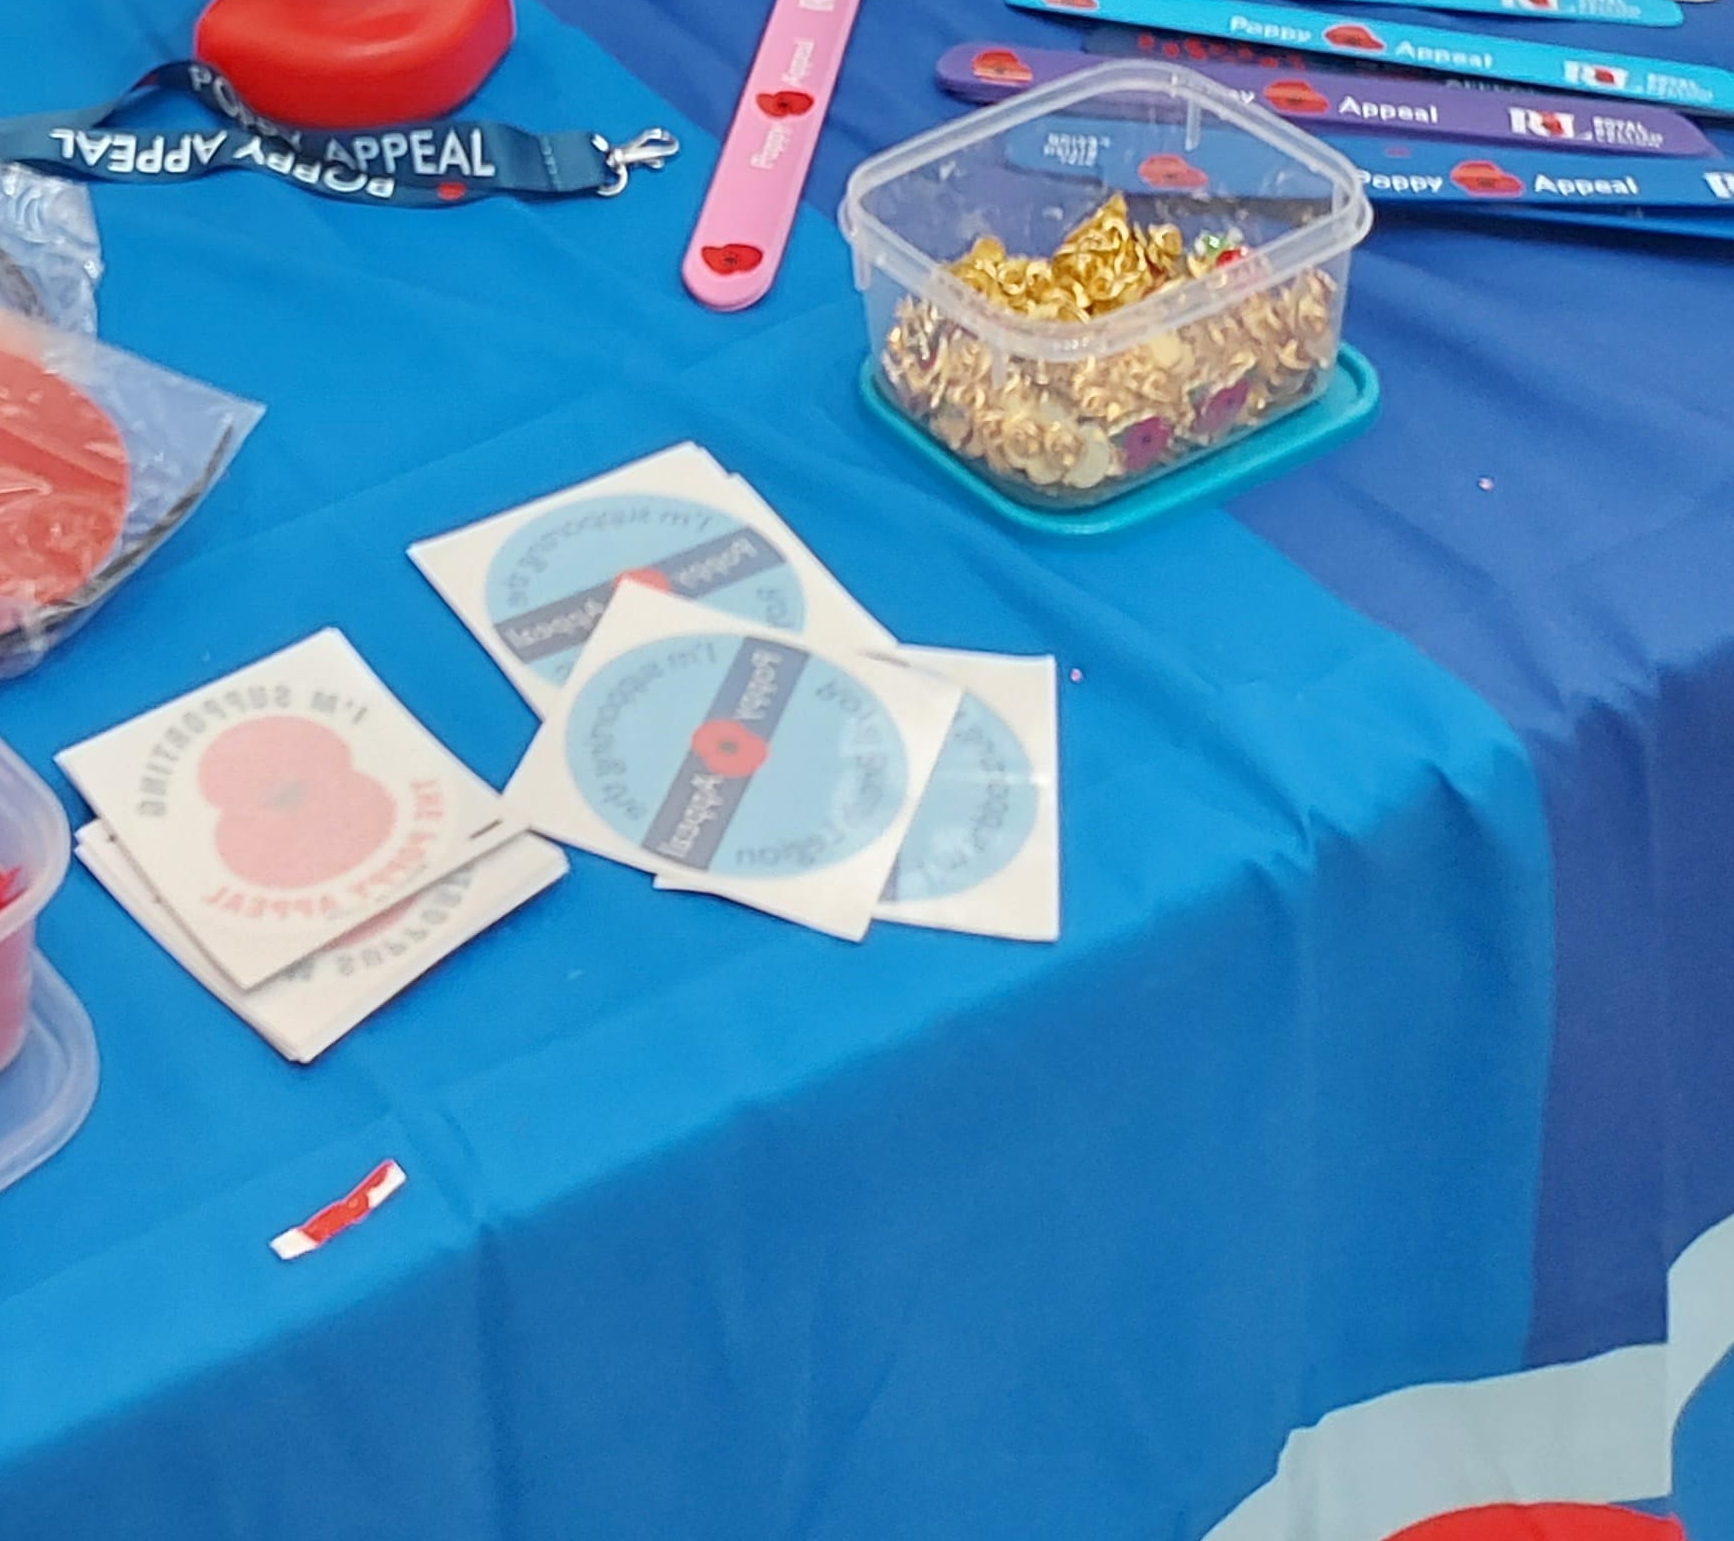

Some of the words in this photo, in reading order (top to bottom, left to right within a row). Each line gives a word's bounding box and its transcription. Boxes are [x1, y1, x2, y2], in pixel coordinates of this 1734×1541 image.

[1337, 95, 1439, 124] Appeal
[49, 128, 228, 175] APPEAL
[232, 136, 395, 199] POPPY
[1357, 168, 1445, 196] Poppy
[1533, 174, 1639, 197] Appeal
